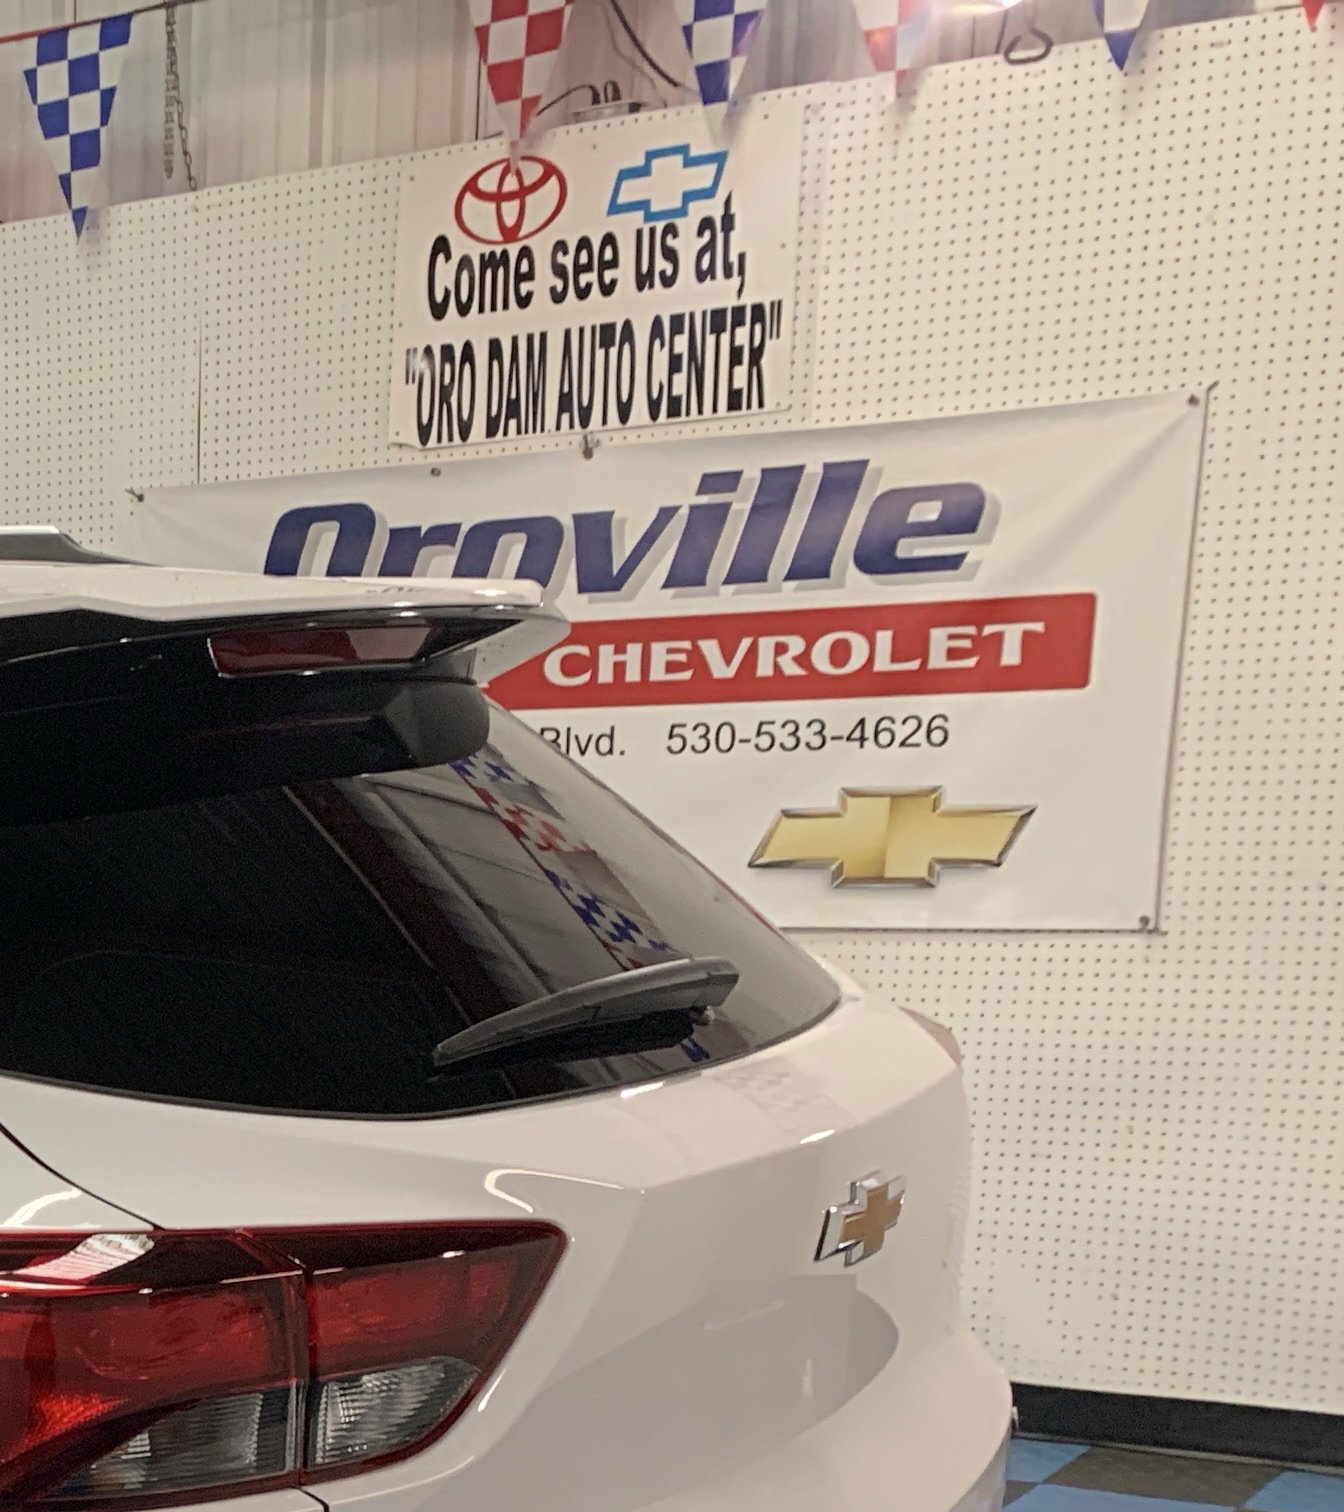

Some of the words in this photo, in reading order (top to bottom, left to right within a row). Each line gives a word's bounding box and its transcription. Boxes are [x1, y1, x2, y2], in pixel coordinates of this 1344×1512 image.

[426, 234, 535, 321] Come
[550, 231, 619, 304] see
[635, 220, 680, 293] us
[695, 190, 748, 297] at,
[404, 337, 477, 447] "ORO
[485, 329, 548, 440] DAM
[555, 317, 637, 433] AUTO
[646, 299, 783, 423] CENTER"
[264, 458, 988, 595] Oroville
[543, 621, 1046, 688] CHEVROLET
[539, 724, 626, 757] Blvd.
[665, 713, 951, 756] 530-533-4626
